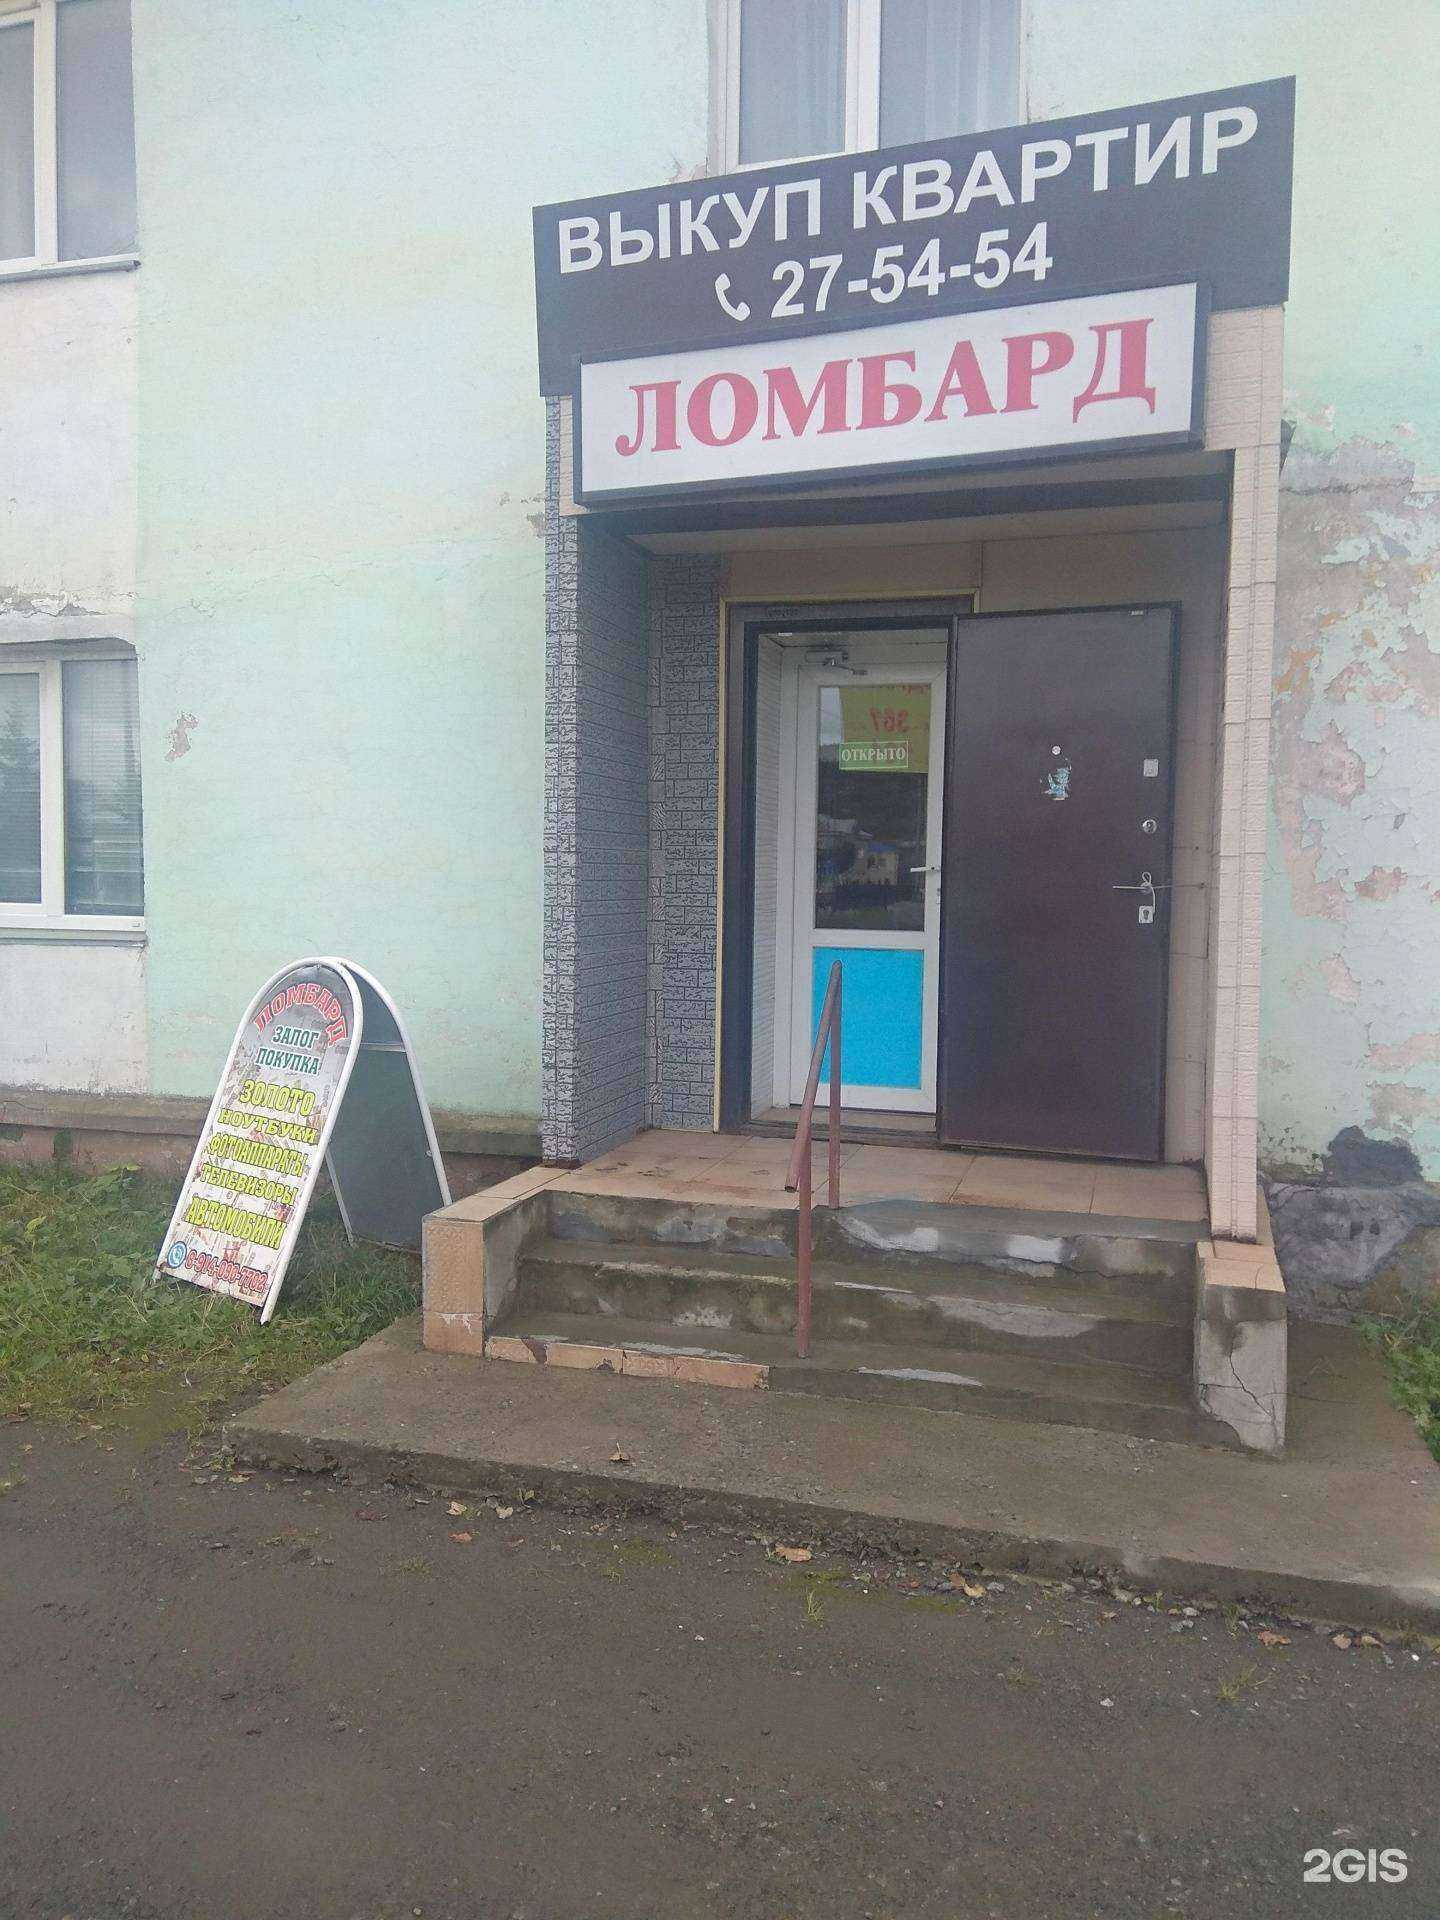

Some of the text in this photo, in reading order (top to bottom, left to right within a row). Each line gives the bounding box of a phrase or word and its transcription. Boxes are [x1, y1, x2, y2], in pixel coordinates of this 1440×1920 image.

[558, 105, 1259, 274] ВЫКУП КВАРТИР
[771, 222, 1053, 319] 27-54-54
[615, 318, 1157, 457] ЛОМБАРД
[841, 747, 906, 762] ОТКРЫТО
[253, 983, 348, 1047] ЛОМБАРД
[272, 1025, 320, 1049] ЗАЛОГ
[255, 1047, 320, 1076] ПОКУПКА
[239, 1079, 316, 1117] ЗОЛОТО
[218, 1108, 318, 1145] НОУТБУКИ
[209, 1133, 309, 1177] ФОТОАППАРАТЫ
[199, 1163, 299, 1206] ТЕЛЕВИЗОРЫ
[184, 1196, 287, 1250] АВТОМОБИЛИ
